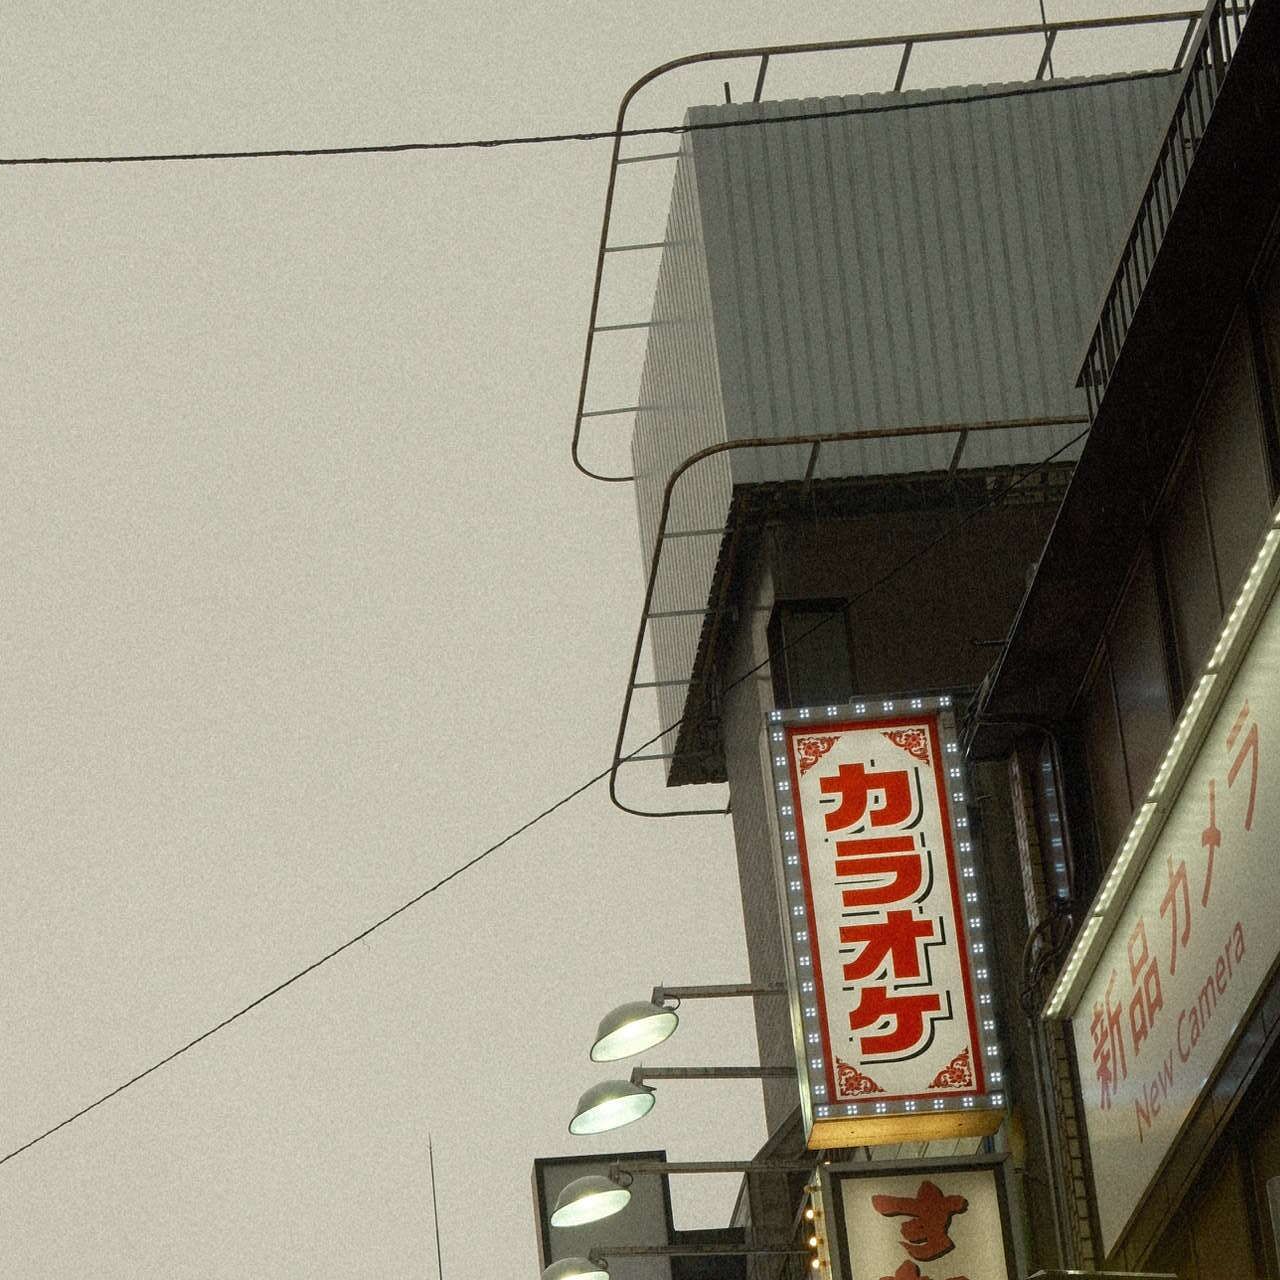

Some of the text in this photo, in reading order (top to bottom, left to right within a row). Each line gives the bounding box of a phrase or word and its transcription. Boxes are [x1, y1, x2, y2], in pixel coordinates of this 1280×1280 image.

[820, 760, 951, 1063] カラオケ
[1089, 699, 1261, 1111] 新品カメラ
[1135, 922, 1247, 1144] New Camera
